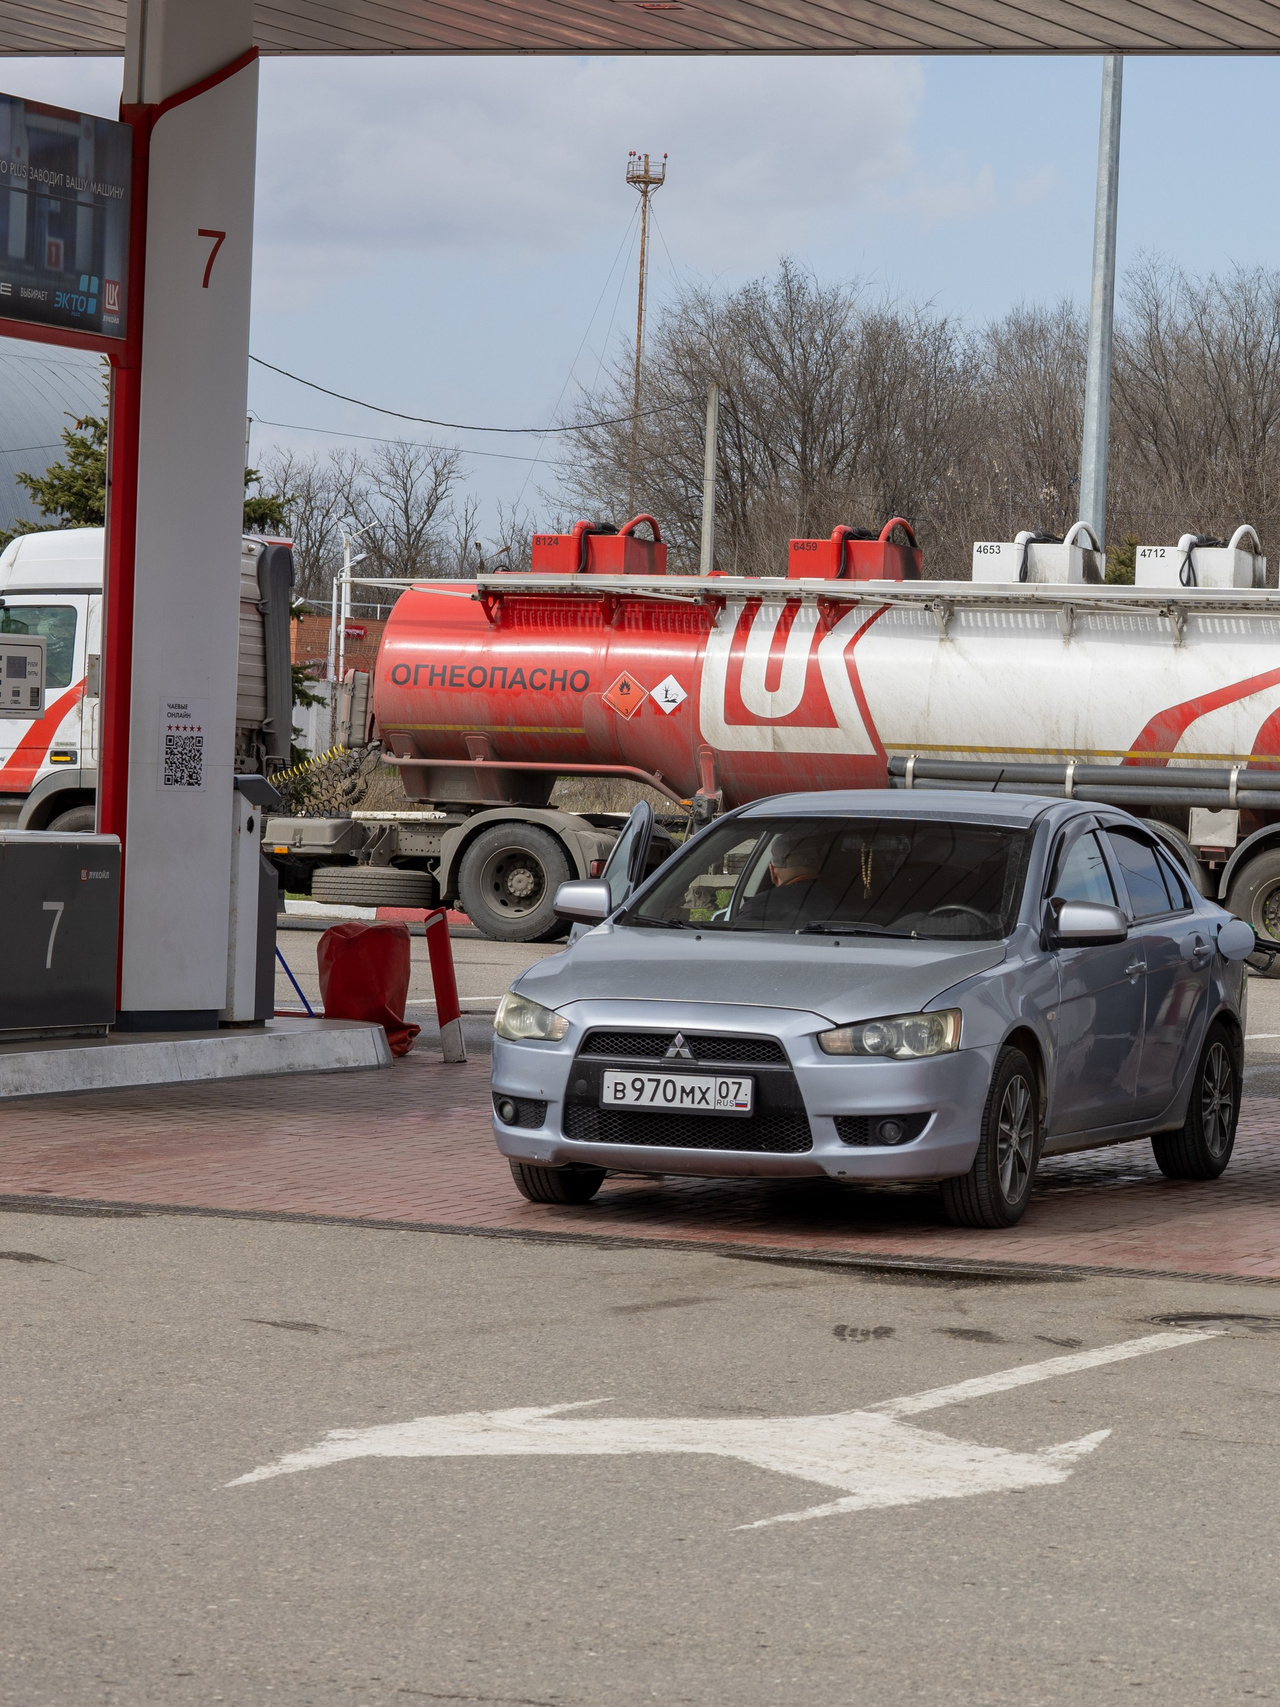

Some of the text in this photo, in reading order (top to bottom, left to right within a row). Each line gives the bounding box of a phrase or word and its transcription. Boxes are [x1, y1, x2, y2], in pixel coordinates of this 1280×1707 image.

[10, 162, 27, 178] PLUS
[29, 167, 64, 187] ЗАВОДИТ
[66, 175, 88, 191] ВАШУ
[90, 181, 124, 199] МАШИНУ
[198, 229, 226, 289] 7
[20, 287, 48, 301] ВЫБИРАЕТ
[53, 291, 87, 312] ЭКТО
[535, 537, 559, 546] 8124
[793, 542, 818, 551] 6459
[976, 545, 1001, 555] 4653
[1140, 548, 1166, 558] 4712
[391, 663, 590, 692] ОГНЕОПАСНО
[167, 711, 191, 719] ОНЛАЙН
[43, 902, 64, 969] 7
[613, 1077, 743, 1106] В970МХ 07
[716, 1099, 735, 1107] RUS
